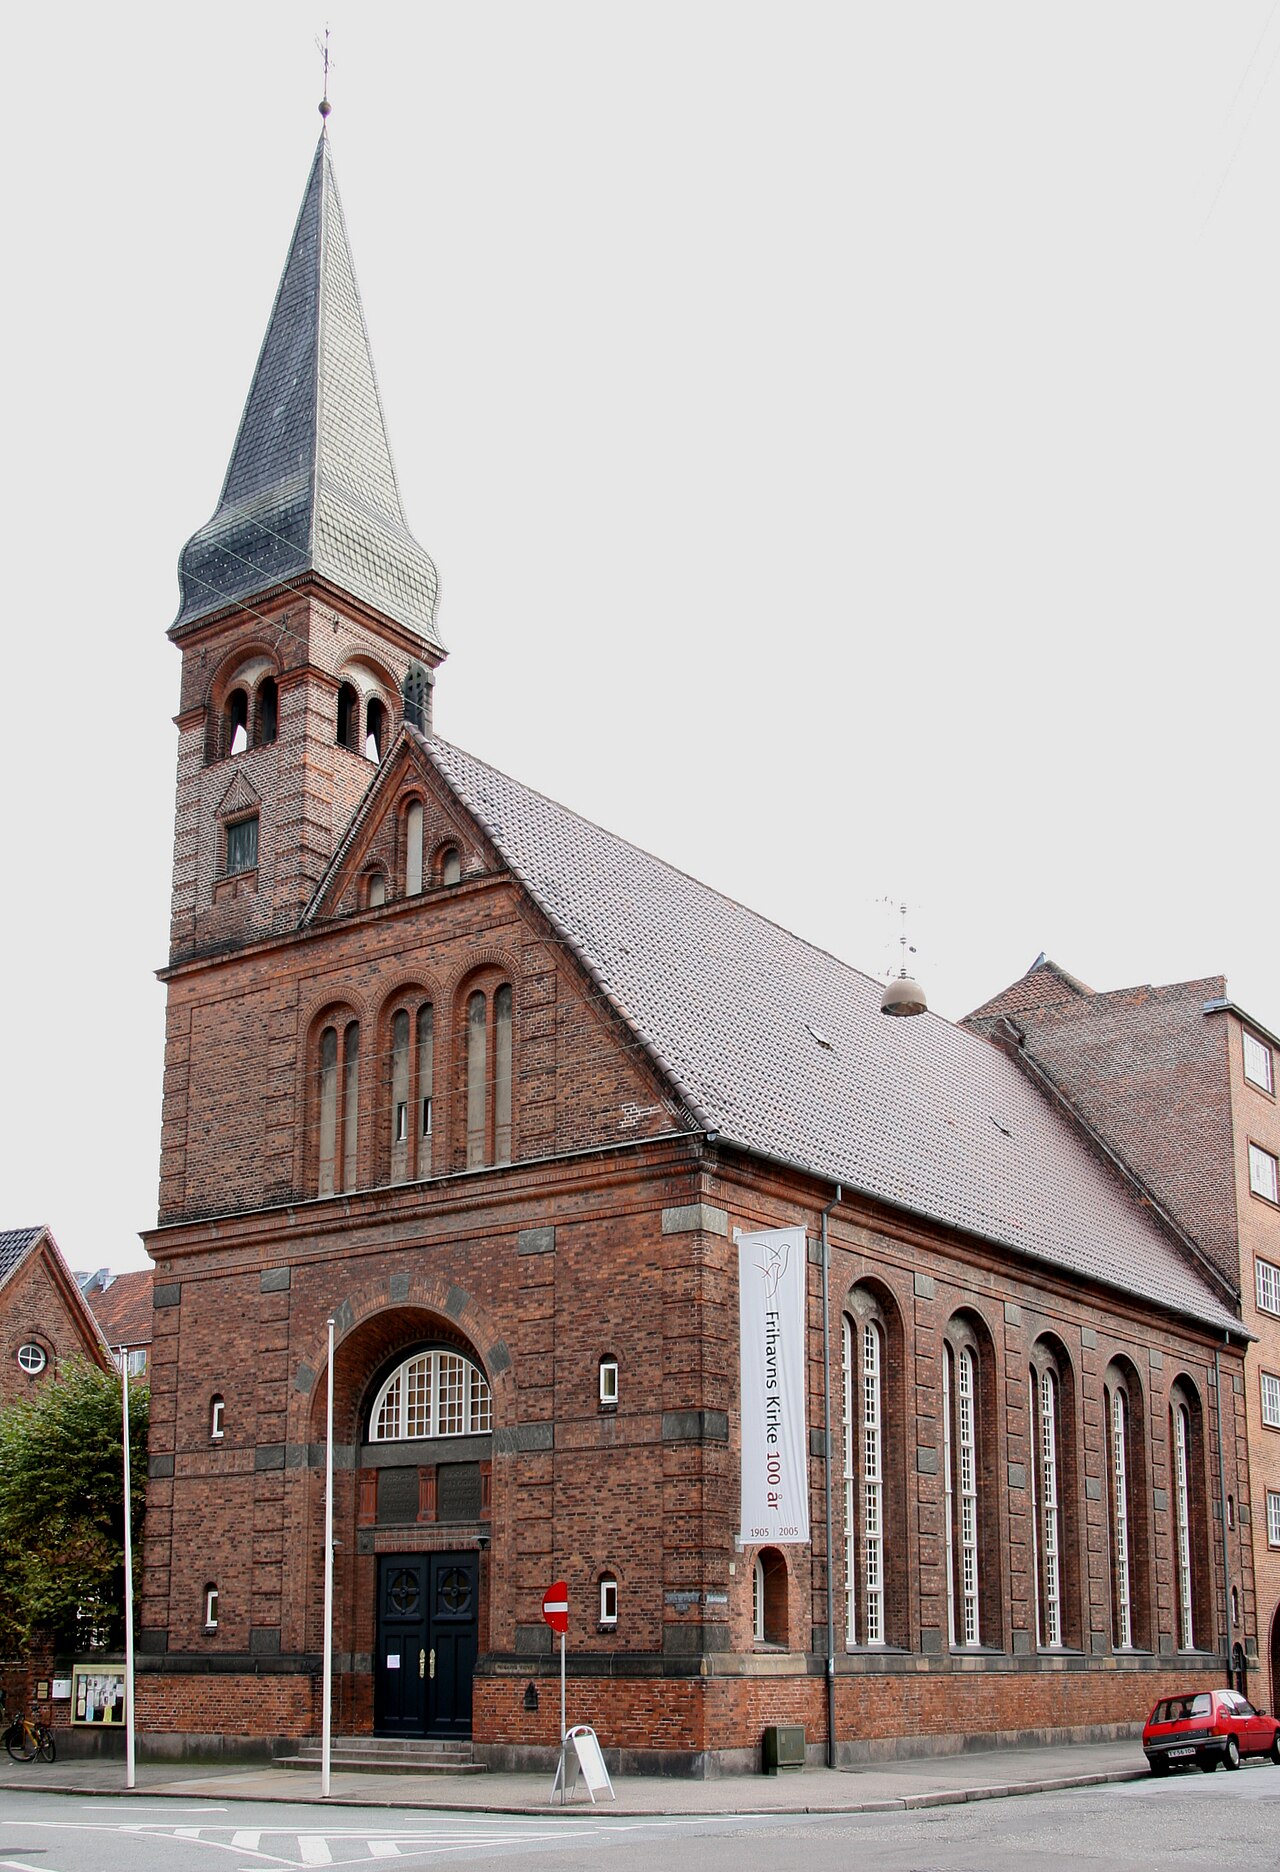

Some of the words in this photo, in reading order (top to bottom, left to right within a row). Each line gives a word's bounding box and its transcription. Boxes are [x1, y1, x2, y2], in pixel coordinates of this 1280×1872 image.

[765, 1311, 781, 1389] Frihavns
[766, 1396, 781, 1444] Kirke
[767, 1451, 781, 1485] 100
[767, 1492, 783, 1510] år
[750, 1527, 770, 1537] 1905
[779, 1526, 799, 1536] 2005
